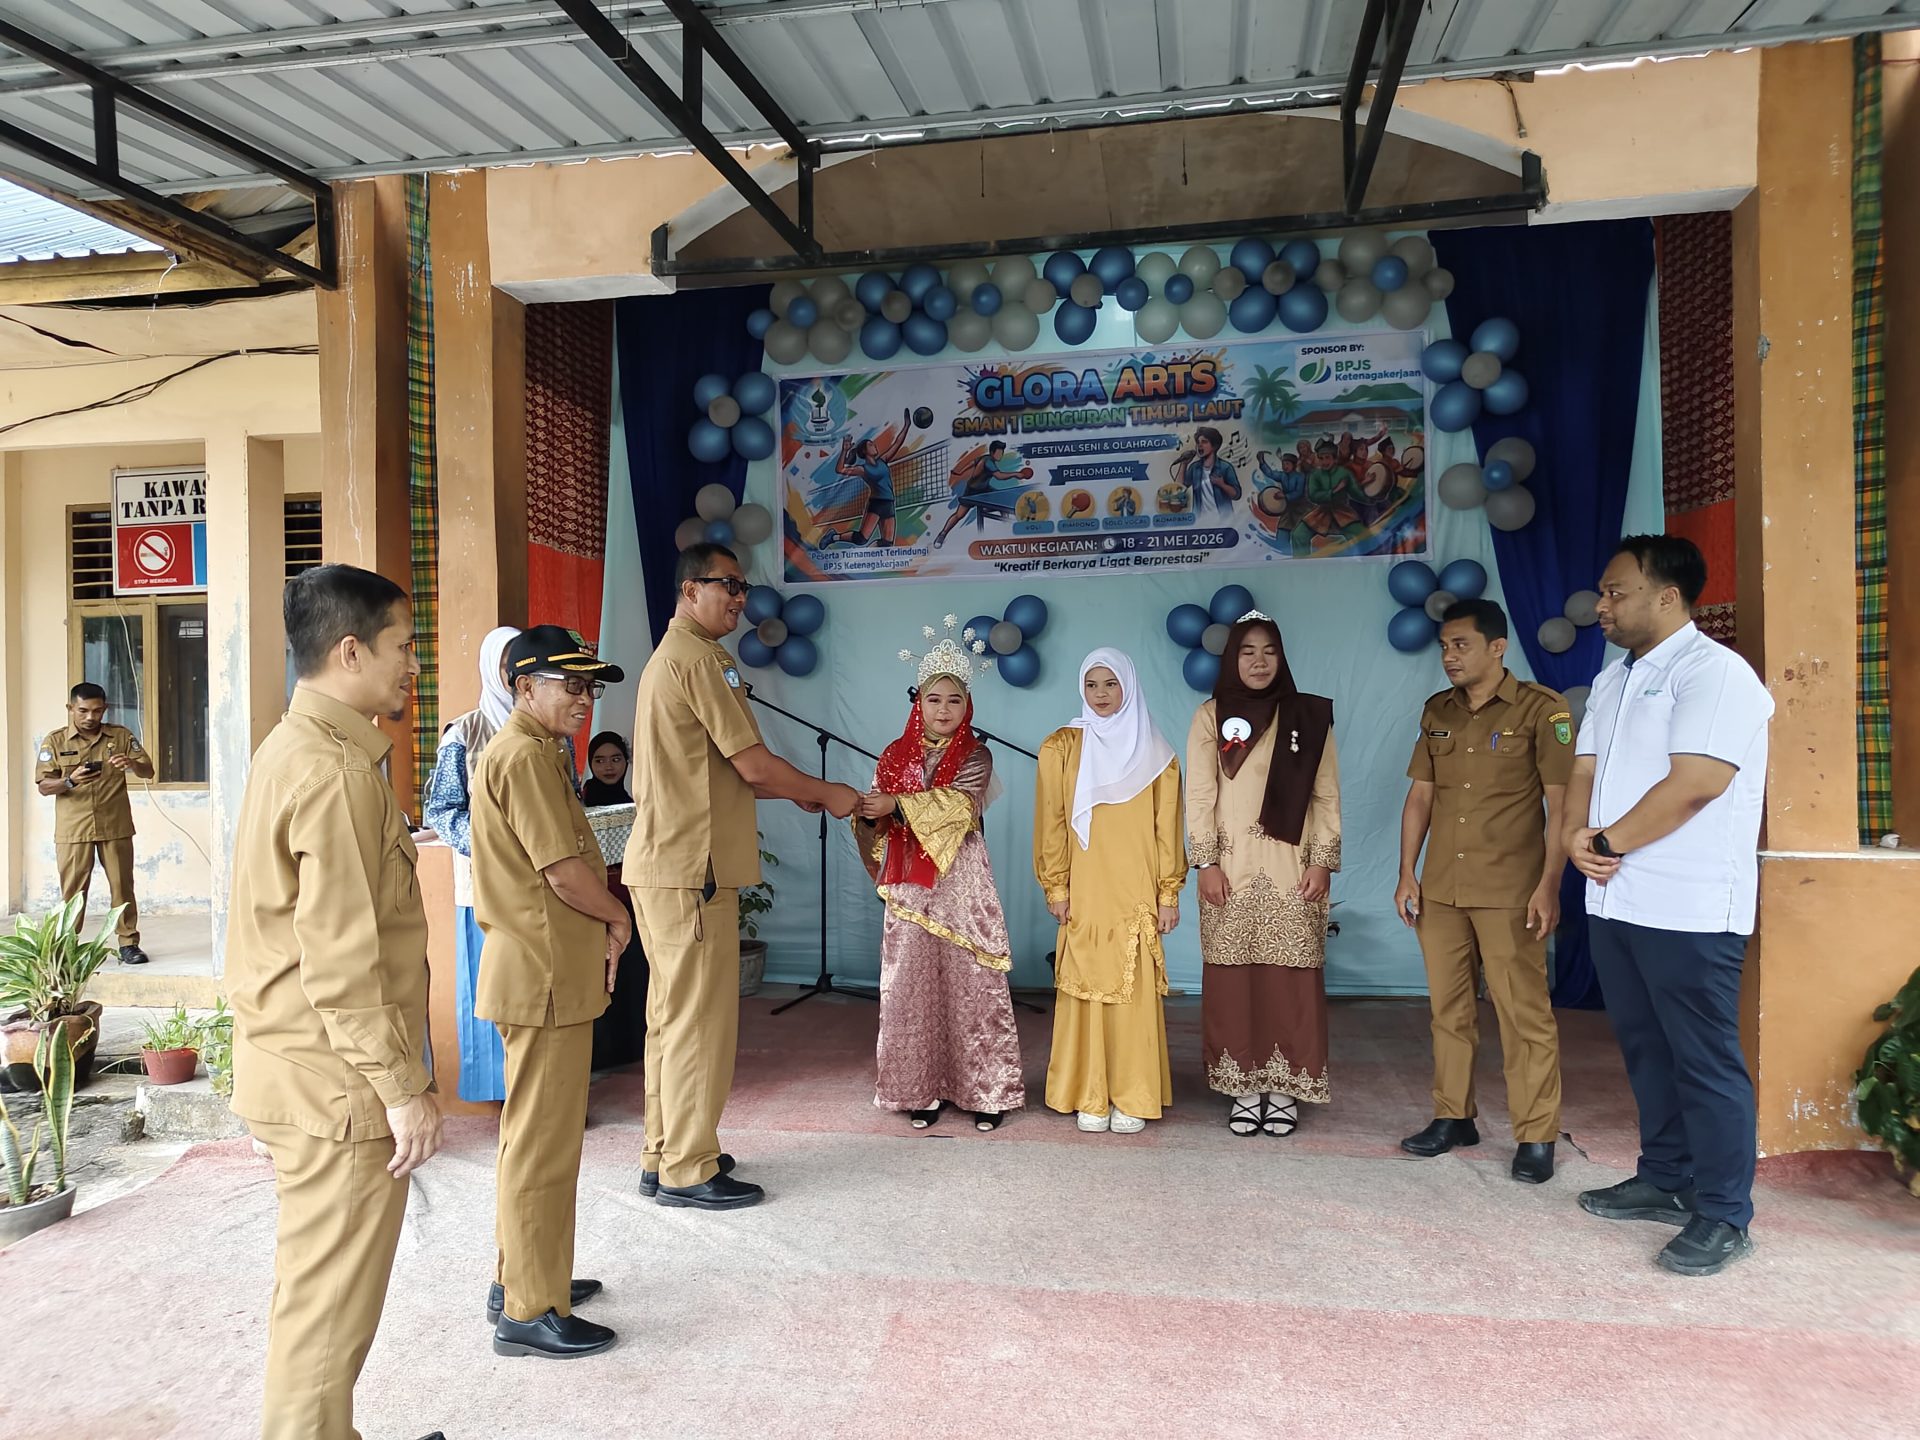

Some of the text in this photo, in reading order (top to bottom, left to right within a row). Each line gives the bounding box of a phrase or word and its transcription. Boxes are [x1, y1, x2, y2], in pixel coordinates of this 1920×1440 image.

[1301, 344, 1365, 356] SPONSOR BY:
[1335, 360, 1371, 372] BPJS
[1335, 369, 1421, 382] Ketenagakerjaan
[976, 361, 1217, 410] GLORA ARTS
[952, 399, 1245, 437] SMAN 1 BUNGURAN TIMUR LAUT
[1031, 439, 1168, 455] FESTIVAL SENI & OLAHRAGA
[1063, 466, 1134, 478] PERLOMBAAN:
[144, 479, 206, 498] KAWA
[121, 499, 187, 518] TANPA
[980, 544, 1028, 556] WAKTU
[1030, 541, 1098, 554] KEGIATAN:
[1121, 537, 1135, 549] 18
[1148, 536, 1160, 548] 21
[1163, 535, 1188, 547] MEI
[1192, 533, 1224, 545] 2026
[841, 550, 884, 559] Turnament
[885, 547, 929, 557] Terlindungi
[823, 562, 842, 571] BPJS
[1043, 558, 1096, 571] Berkarya
[1100, 556, 1131, 568] Ligat
[1232, 727, 1240, 736] 2
